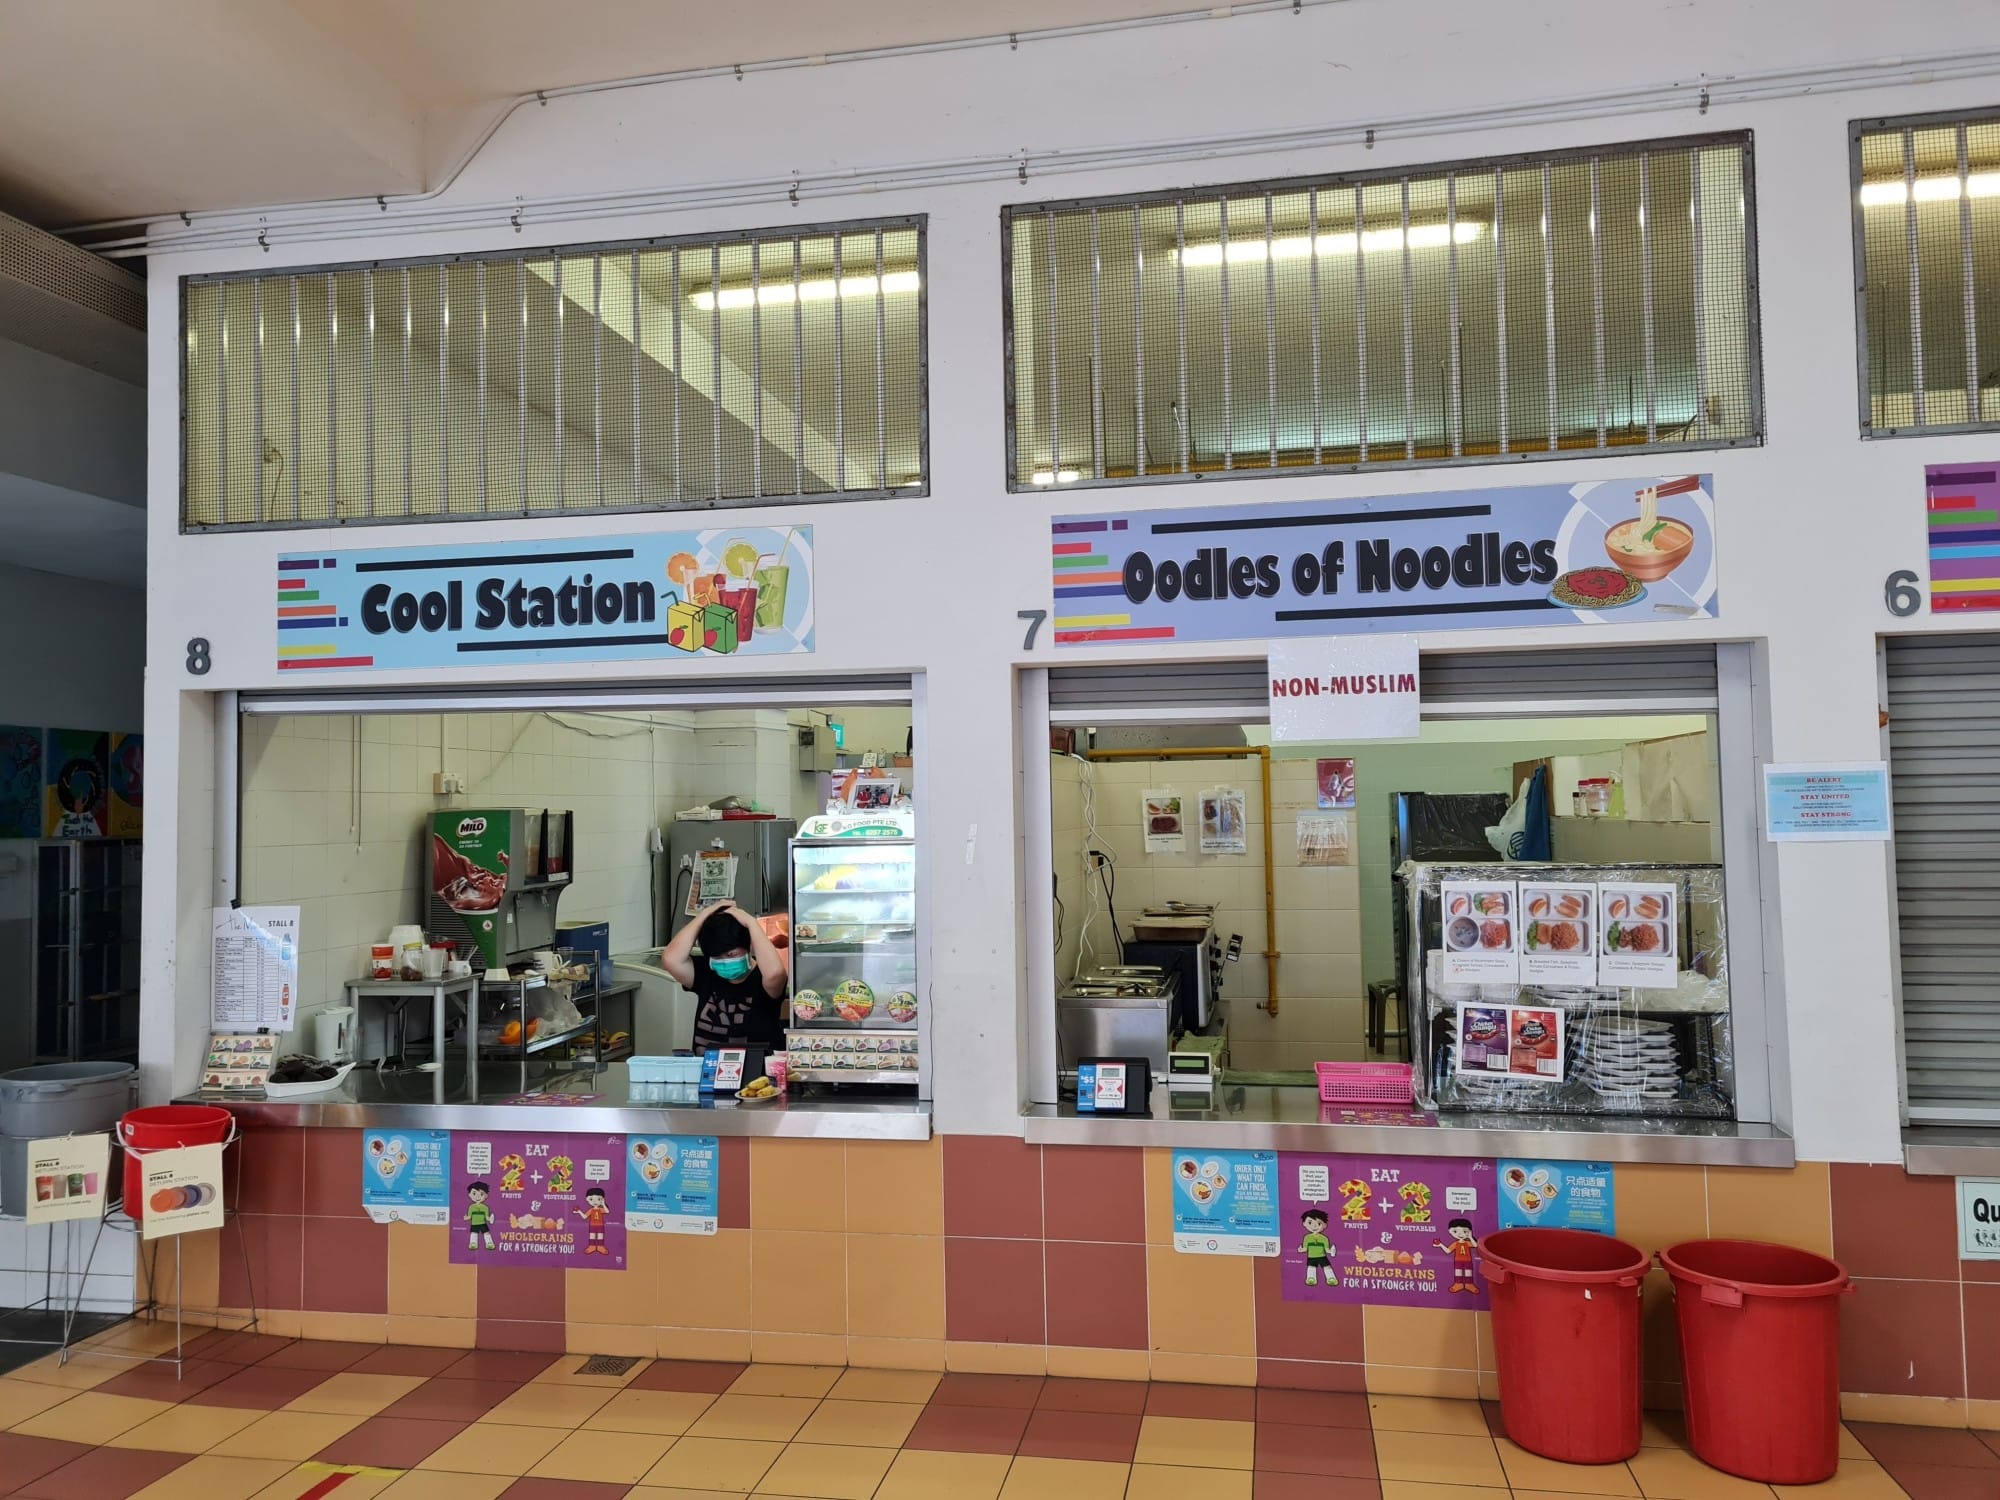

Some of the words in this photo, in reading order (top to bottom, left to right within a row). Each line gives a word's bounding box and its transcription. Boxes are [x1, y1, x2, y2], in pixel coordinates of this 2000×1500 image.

[1123, 546, 1281, 604] Oodles
[1292, 540, 1345, 596] of
[1356, 532, 1559, 594] Noodles
[1885, 569, 1921, 617] 6
[361, 580, 463, 635] Cool
[475, 573, 656, 630] Station
[1016, 609, 1047, 651] 7
[185, 637, 212, 676] 8
[1272, 673, 1416, 698] NON-MUSLIM
[460, 822, 484, 833] MILO
[525, 1144, 549, 1156] EAT
[498, 1154, 526, 1191] 2
[546, 1155, 574, 1192] 2
[1234, 1164, 1252, 1173] ORDER
[1253, 1165, 1267, 1174] ONLY
[1236, 1174, 1252, 1182] WHAT
[1253, 1174, 1264, 1182] YOU
[1370, 1168, 1400, 1183] EAT
[1566, 1176, 1606, 1187] 只点适量
[1236, 1182, 1248, 1191] CAN
[1570, 1187, 1601, 1198] 的食物
[531, 1200, 541, 1212] &
[1338, 1178, 1373, 1221] 2
[1398, 1180, 1432, 1223] 2
[1395, 1224, 1437, 1232] VEGETABLES
[500, 1232, 574, 1243] WHOLEGRAINS
[1380, 1232, 1393, 1244] &
[499, 1243, 513, 1252] FOR
[515, 1244, 520, 1252] A
[521, 1243, 558, 1253] STRONGER
[558, 1244, 575, 1254] YOU!
[1344, 1266, 1436, 1280] WHOLEGRAINS
[1343, 1278, 1361, 1288] FOR
[1363, 1278, 1369, 1288] A
[1370, 1279, 1415, 1291] STRONGER
[1417, 1281, 1438, 1292] YOU!
